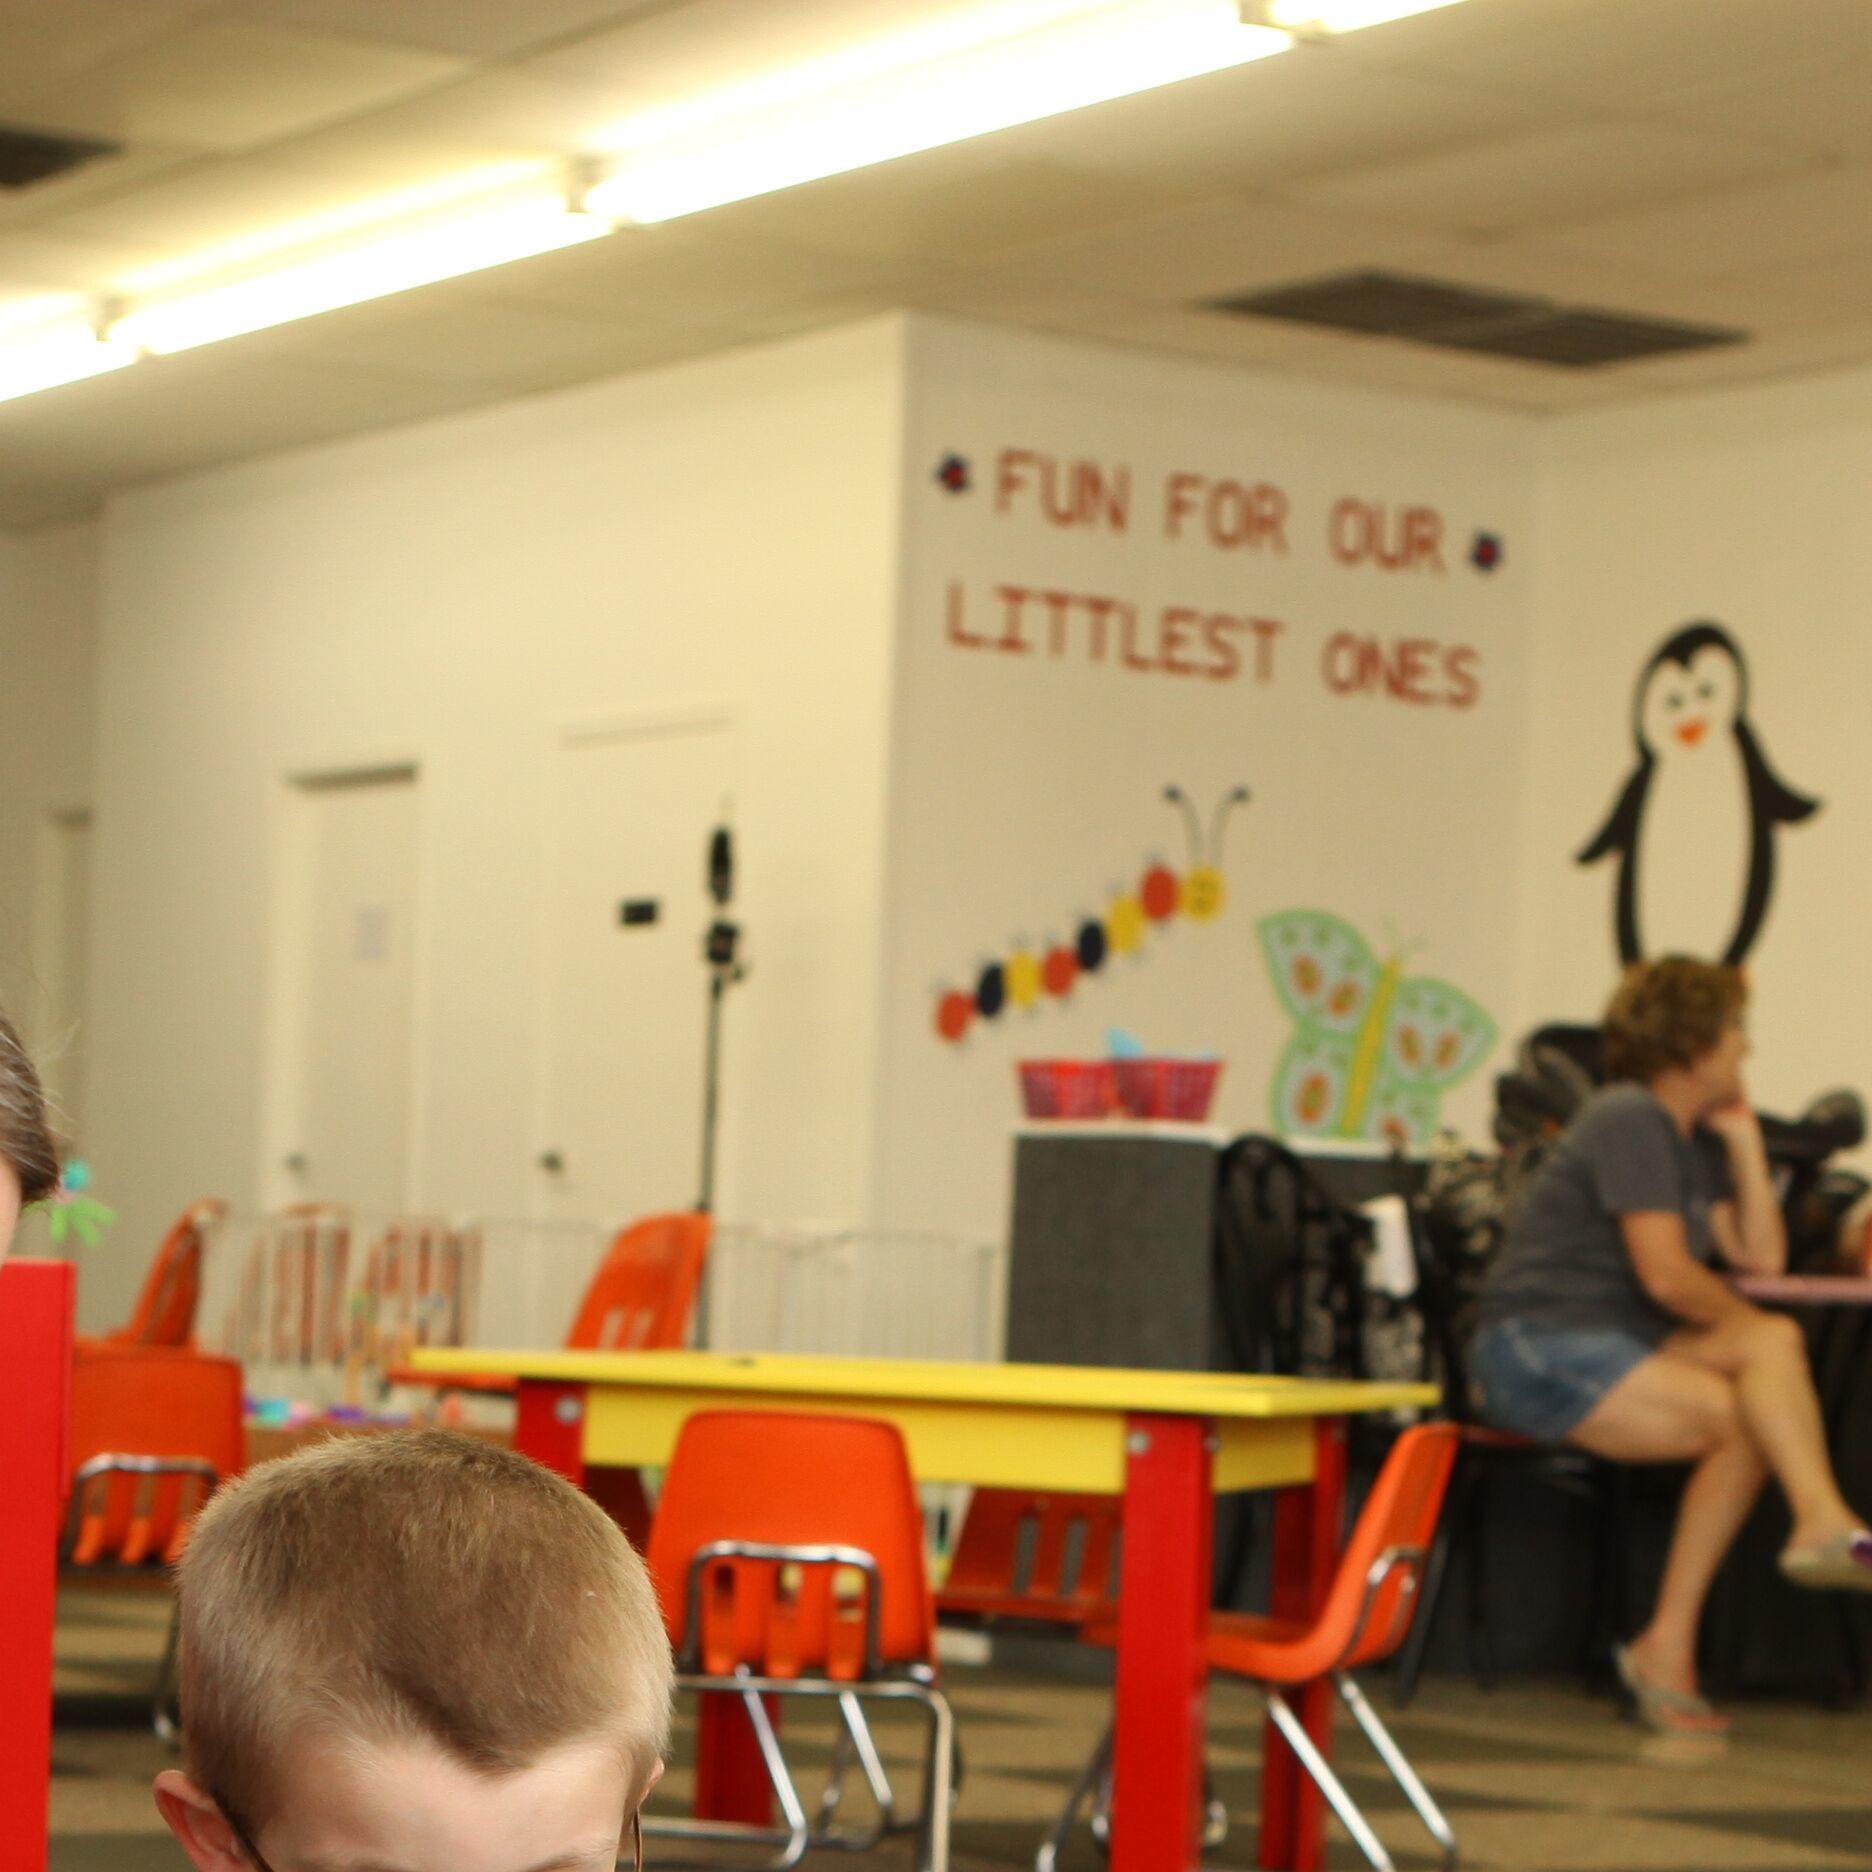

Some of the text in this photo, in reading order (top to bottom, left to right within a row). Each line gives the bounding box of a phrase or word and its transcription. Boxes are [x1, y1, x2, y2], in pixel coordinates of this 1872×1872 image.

[993, 447, 1447, 573] FUN FOR OUR
[944, 580, 1483, 712] LITTLEST ONES
